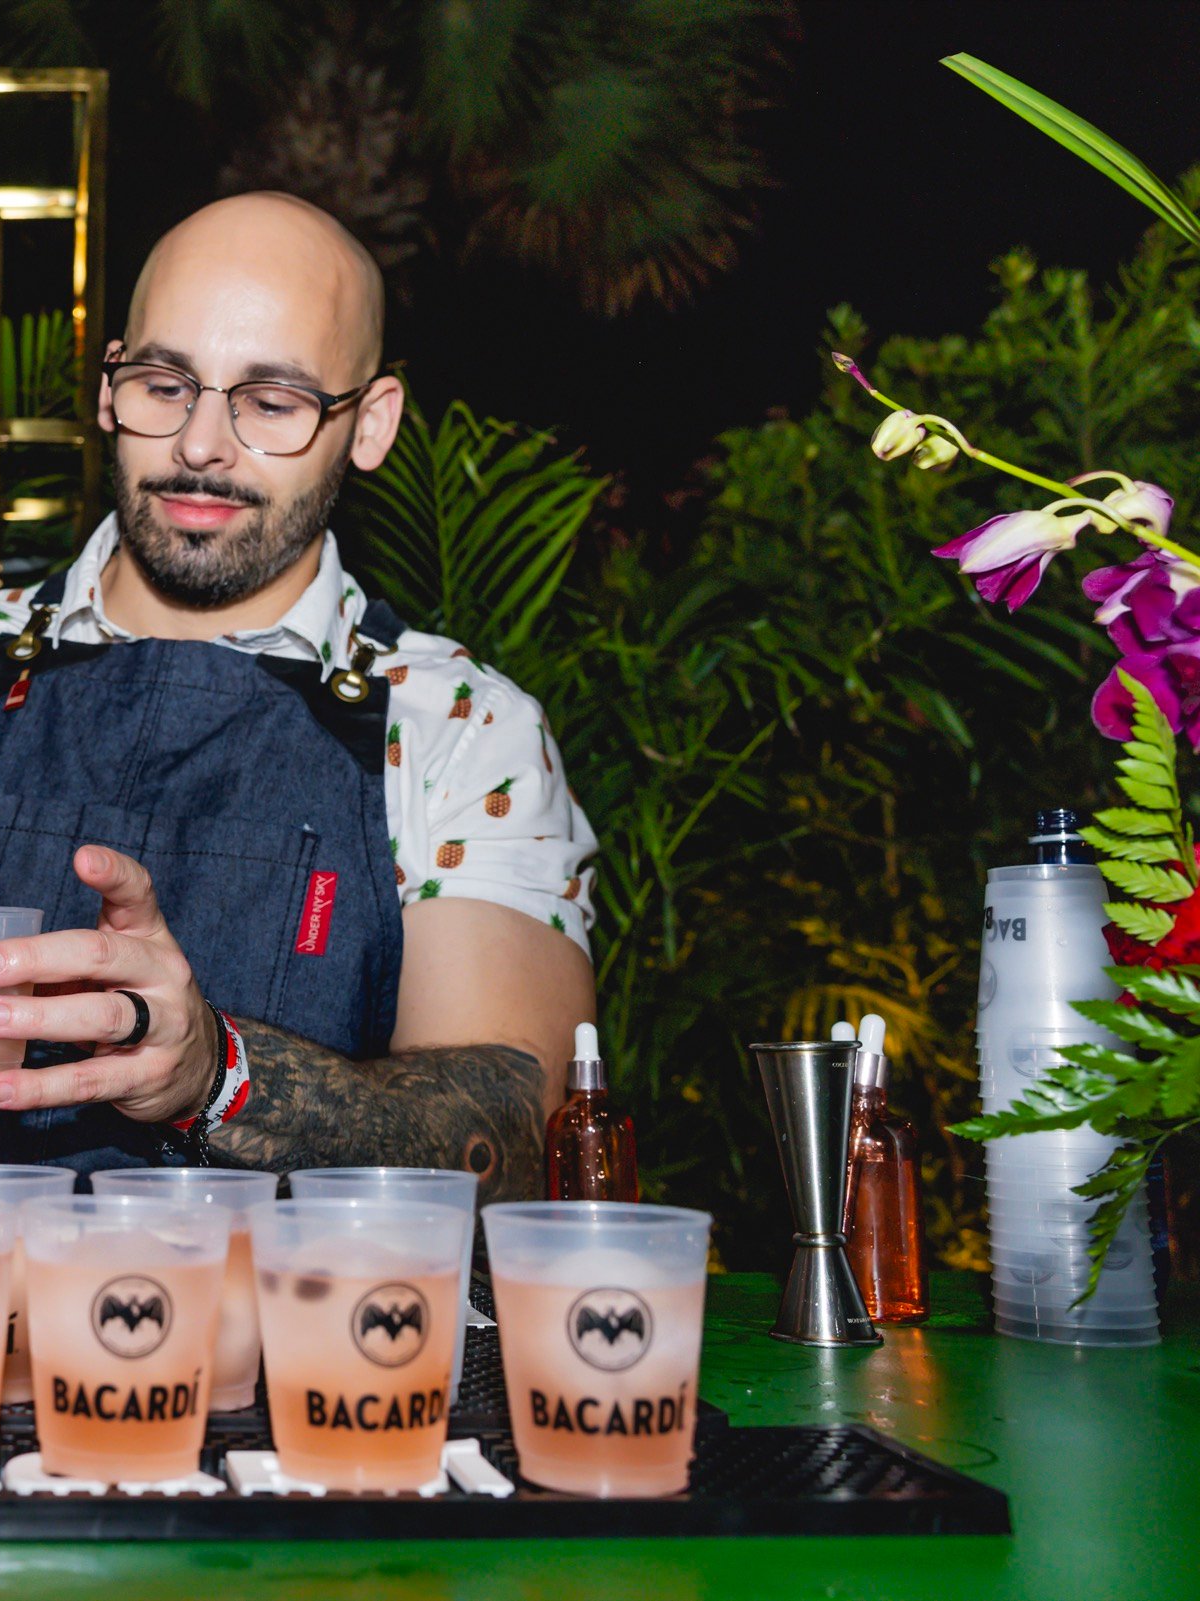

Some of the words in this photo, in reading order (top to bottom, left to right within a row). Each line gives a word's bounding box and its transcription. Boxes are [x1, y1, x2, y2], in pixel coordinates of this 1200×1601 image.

[314, 874, 335, 896] SKY
[312, 896, 333, 913] NY
[298, 914, 321, 952] UNDER
[52, 1368, 202, 1421] BACARDÍ
[530, 1380, 688, 1436] BACARDÍ
